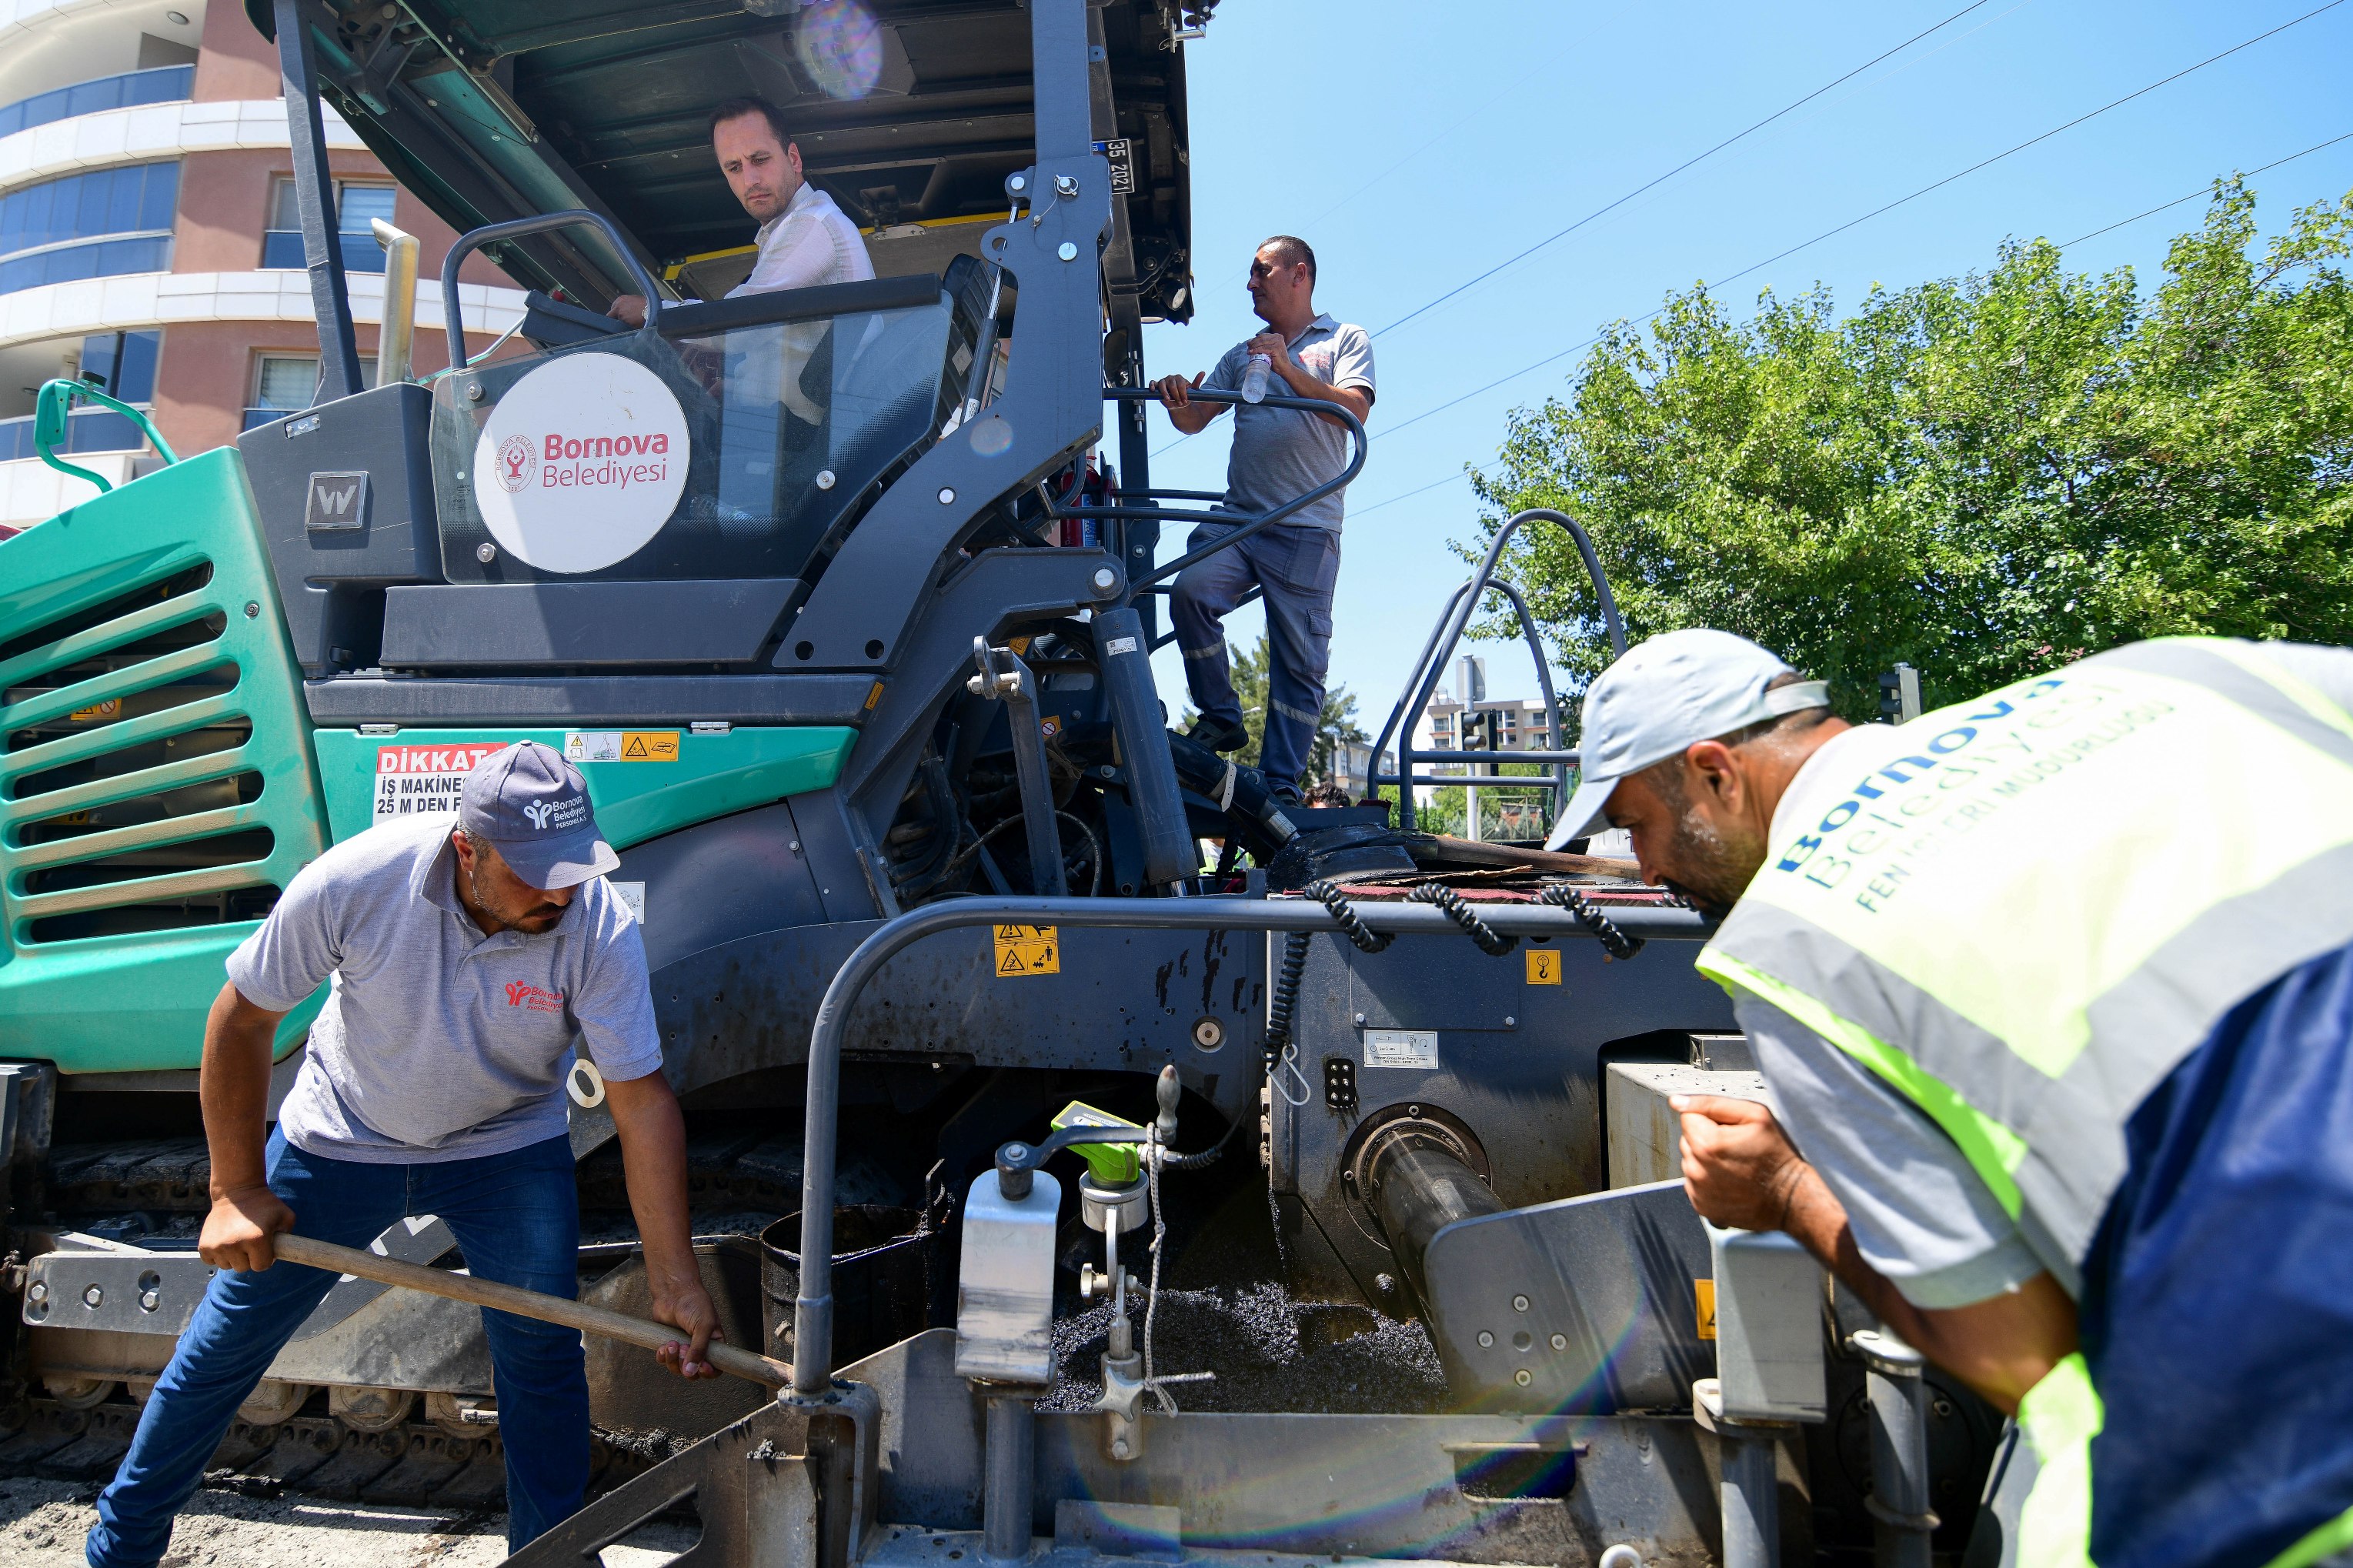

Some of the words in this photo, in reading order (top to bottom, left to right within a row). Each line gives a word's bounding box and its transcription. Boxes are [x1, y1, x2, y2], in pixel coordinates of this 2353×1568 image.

[1108, 142, 1126, 157] 35
[1110, 165, 1130, 191] 2021
[496, 439, 514, 471] BORNOVA
[544, 433, 669, 461] Bornova
[542, 458, 667, 489] Belediyesi
[380, 747, 488, 773] DİKKAT
[382, 776, 396, 798] İŞ
[401, 774, 466, 794] MAKİNE
[1776, 679, 2066, 873] Bornova
[1805, 683, 2124, 889] Belediyesi
[377, 799, 395, 814] 25
[399, 798, 412, 813] M
[416, 796, 448, 812] DEN
[552, 796, 583, 812] Bornova
[554, 804, 585, 821] Belediyesi
[556, 818, 580, 829] PERSONEL
[1855, 863, 1912, 914] FEN
[529, 996, 563, 1009] Belediye
[531, 986, 563, 1000] Bornov
